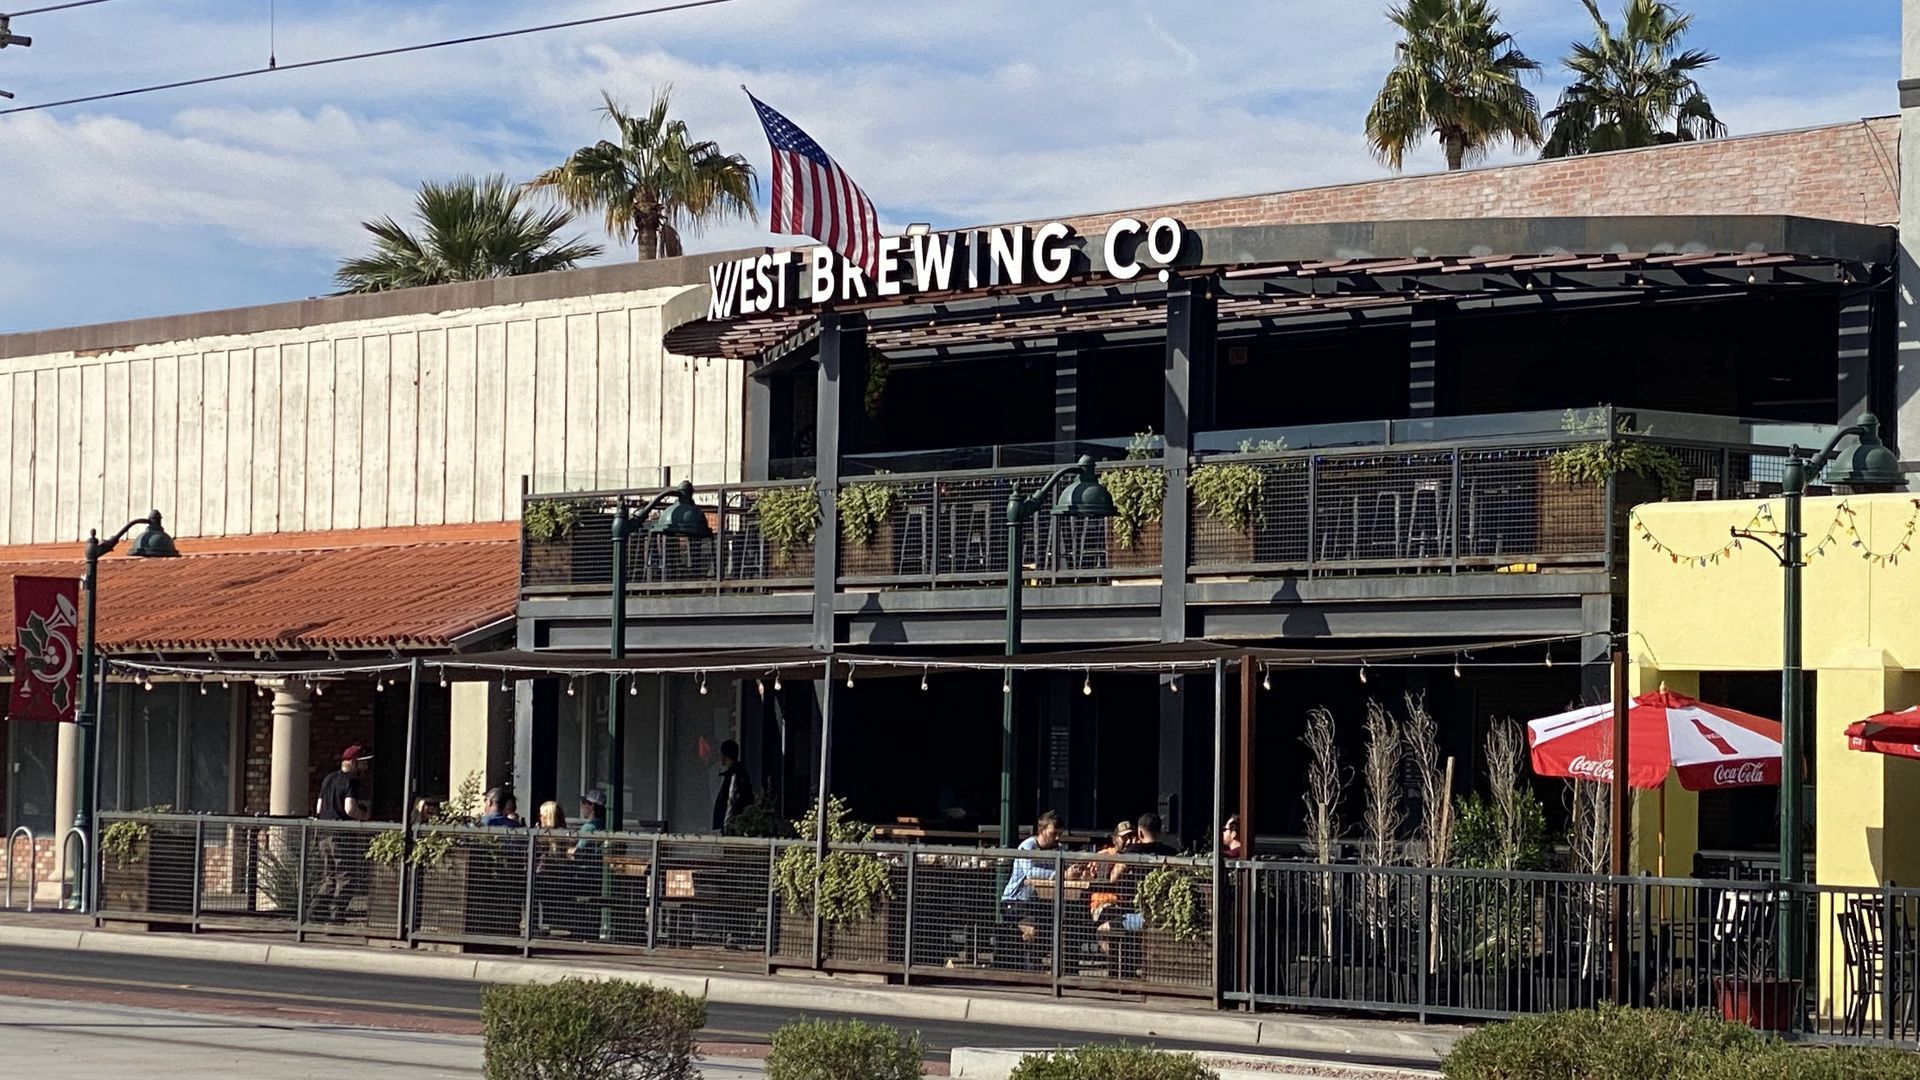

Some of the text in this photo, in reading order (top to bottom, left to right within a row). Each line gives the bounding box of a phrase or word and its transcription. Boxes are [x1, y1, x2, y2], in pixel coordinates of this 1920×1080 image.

[707, 251, 791, 321] WEST
[812, 222, 1072, 303] BREWING
[1713, 762, 1764, 785] Coca-Cola
